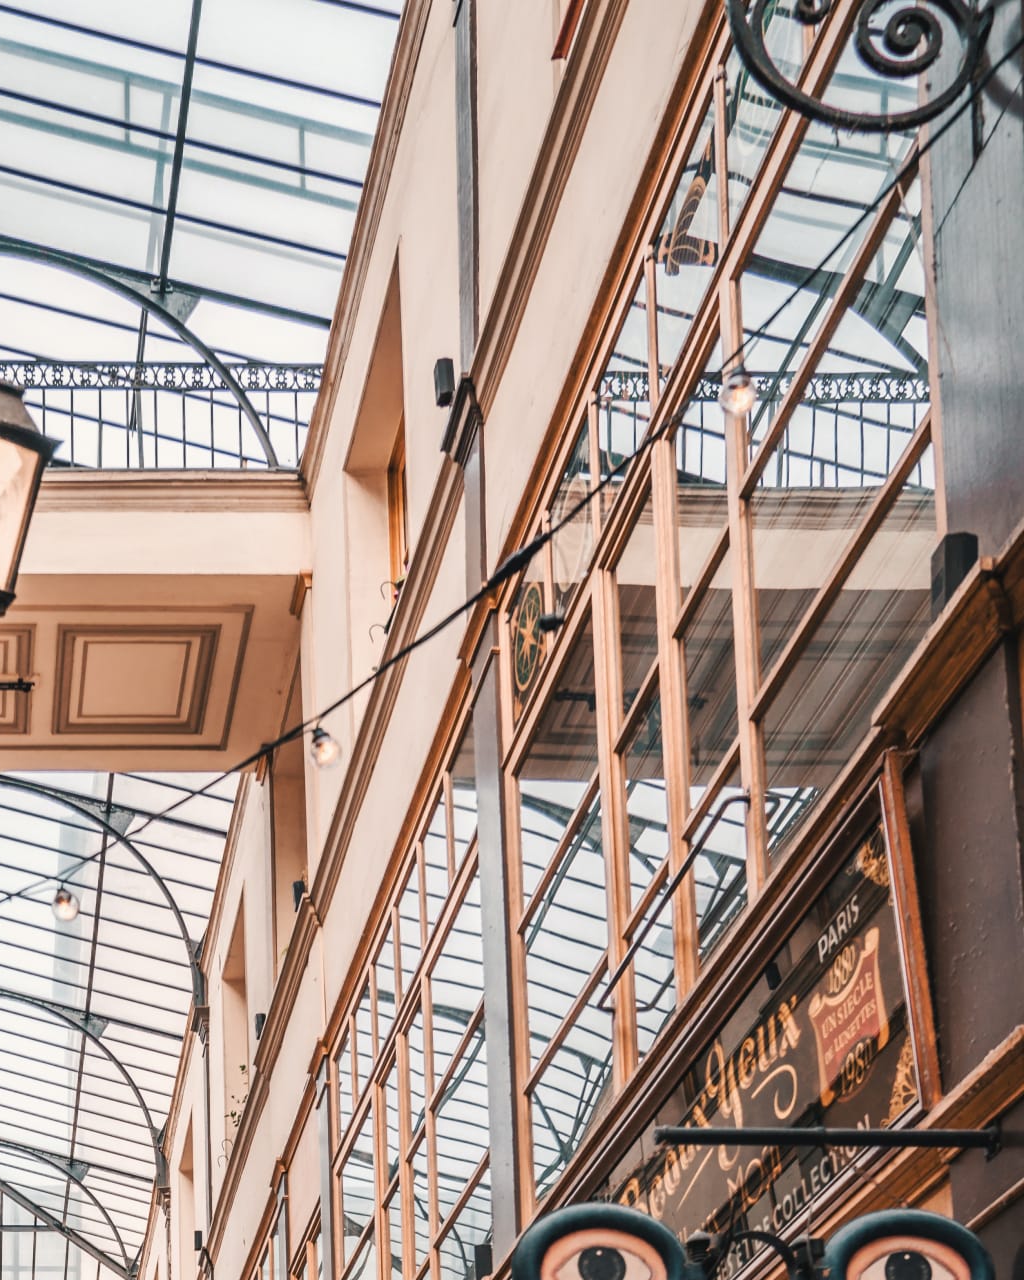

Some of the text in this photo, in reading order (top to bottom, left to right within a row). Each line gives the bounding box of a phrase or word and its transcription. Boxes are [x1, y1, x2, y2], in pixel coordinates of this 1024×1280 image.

[818, 894, 860, 963] PARIS
[822, 971, 874, 1039] UN SIECLE
[833, 998, 877, 1053] LUNETTES
[840, 1037, 873, 1096] 1980
